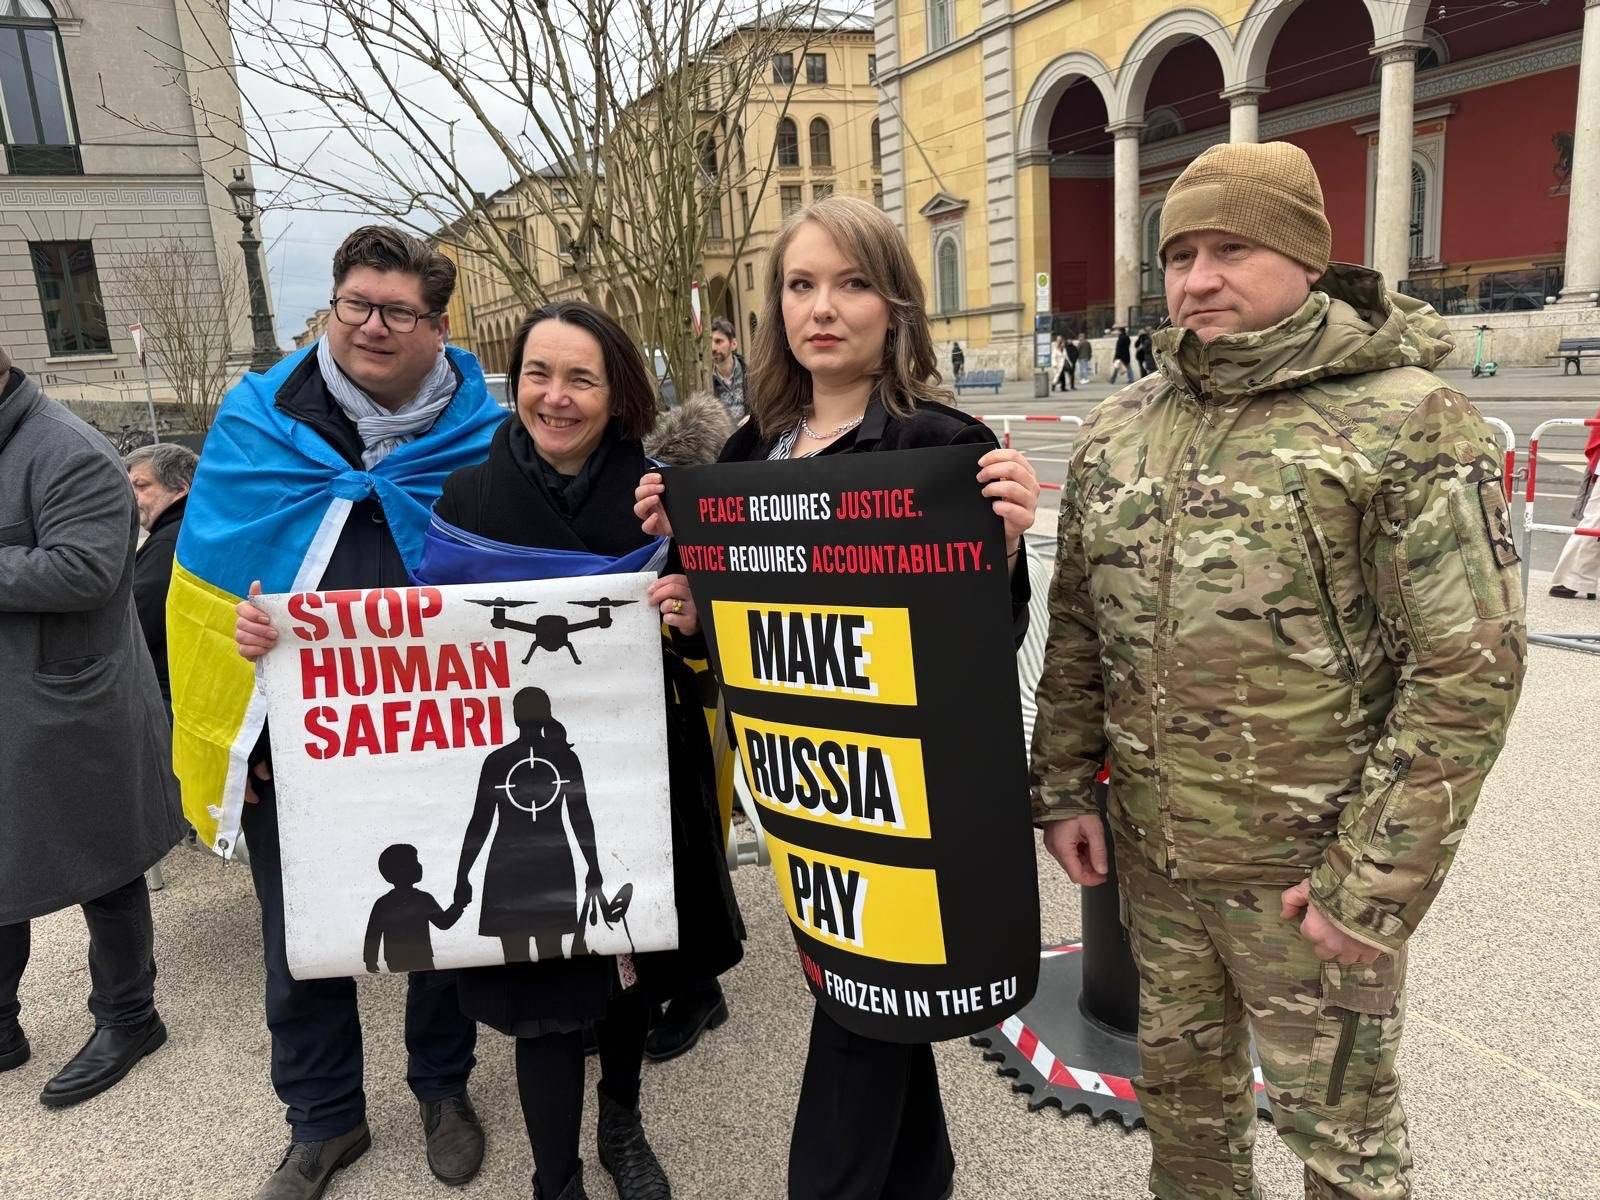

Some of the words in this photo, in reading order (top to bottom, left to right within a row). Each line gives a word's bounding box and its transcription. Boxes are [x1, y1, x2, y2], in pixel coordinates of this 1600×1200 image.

[699, 496, 746, 523] PEACE
[749, 492, 831, 523] REQUIRES
[836, 488, 923, 521] JUSTICE.
[729, 544, 808, 573] REQUIRES
[811, 541, 992, 575] ACCOUNTABILITY.
[287, 587, 443, 642] STOP
[299, 640, 511, 700] HUMAN
[747, 609, 879, 697] MAKE
[303, 696, 504, 760] SAFARI
[744, 728, 907, 831] RUSSIA
[787, 852, 869, 949] PAY
[824, 969, 899, 1017] FROZEN
[904, 990, 931, 1018] IN
[936, 986, 984, 1017] THE
[990, 976, 1018, 1007] EU
